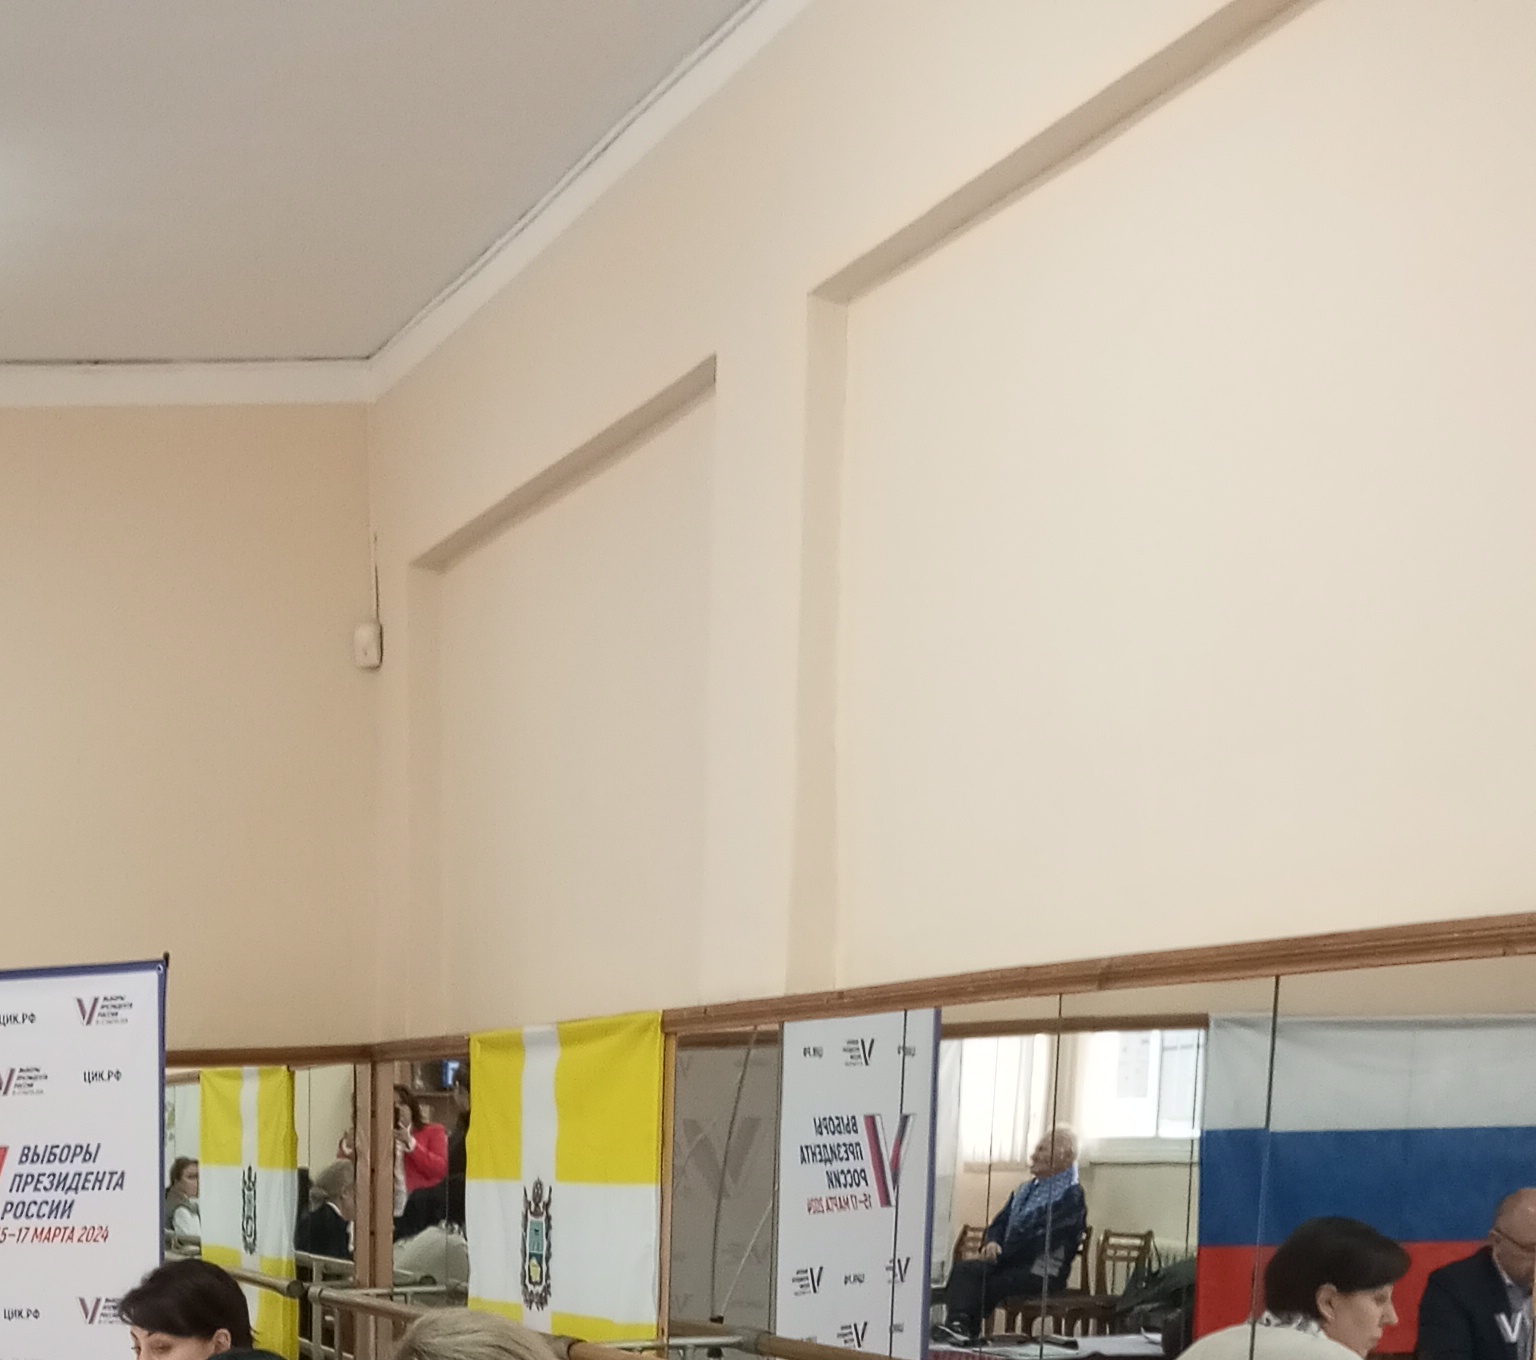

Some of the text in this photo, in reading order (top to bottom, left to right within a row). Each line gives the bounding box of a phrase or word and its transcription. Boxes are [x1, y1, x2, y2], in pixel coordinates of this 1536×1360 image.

[83, 1069, 122, 1084] ЦИК.РФ
[18, 1143, 101, 1166] ВЫБОРЫ
[9, 1170, 126, 1194] ПРЕЗИДЕНТА
[0, 1199, 75, 1220] РОССИИ
[31, 1226, 75, 1244] МАРТА
[77, 1225, 109, 1243] 2024
[3, 1308, 40, 1321] ЦИК.РФ
